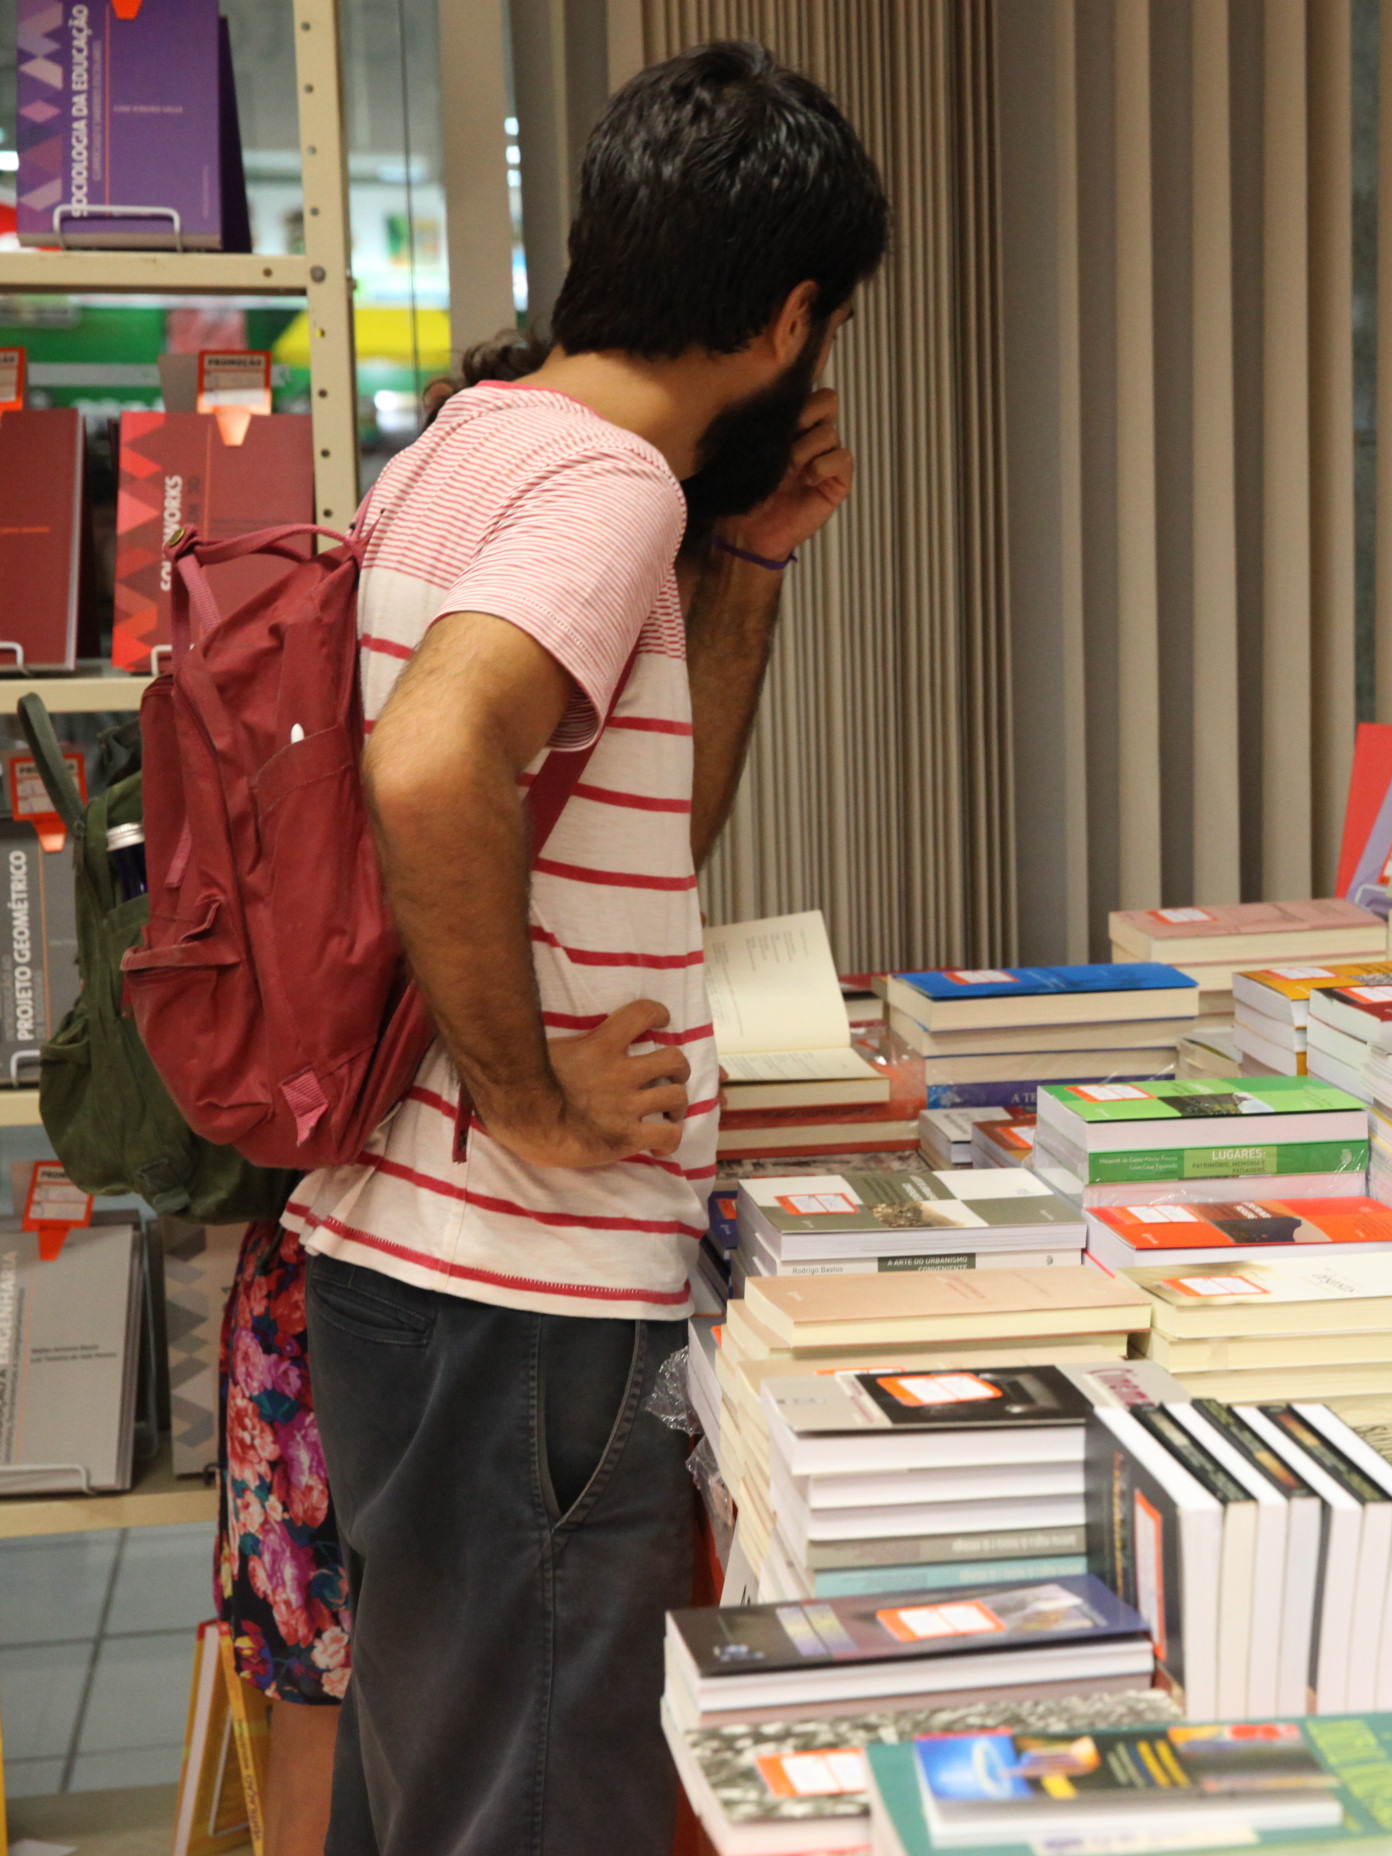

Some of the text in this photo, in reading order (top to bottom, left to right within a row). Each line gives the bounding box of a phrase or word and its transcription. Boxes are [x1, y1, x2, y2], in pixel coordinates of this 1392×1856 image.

[68, 4, 91, 218] SOCIOLOGIA DA EDUCAÇÃO
[7, 850, 35, 1041] PROJETO GEOMÉTRICO
[1211, 1148, 1266, 1161] LUGARES:
[925, 1256, 968, 1265] URBANISMO
